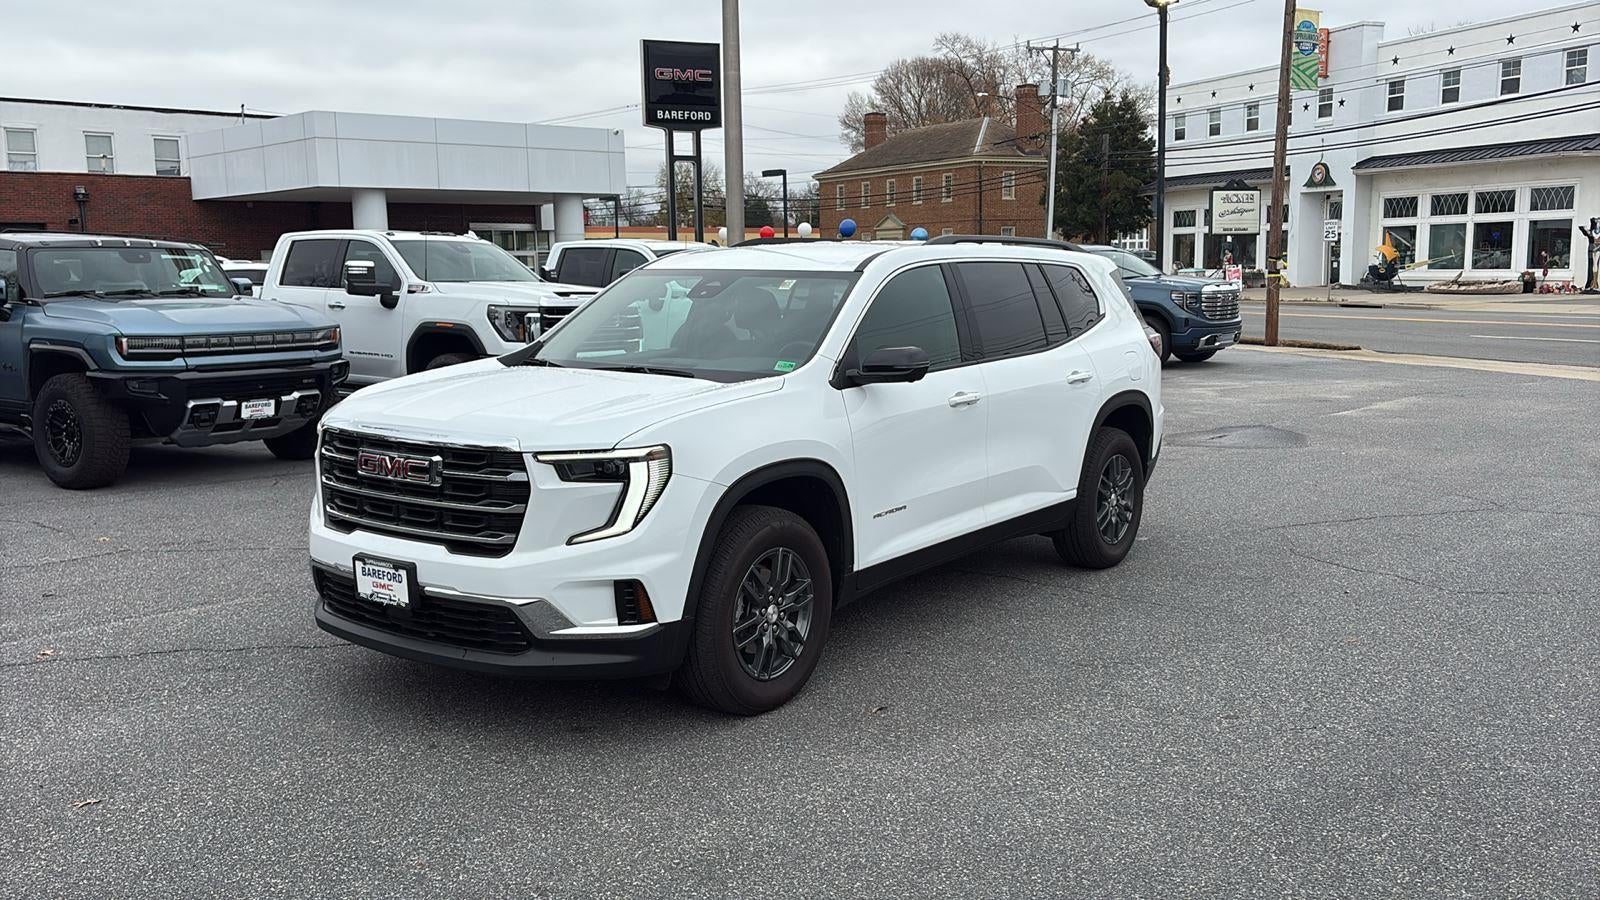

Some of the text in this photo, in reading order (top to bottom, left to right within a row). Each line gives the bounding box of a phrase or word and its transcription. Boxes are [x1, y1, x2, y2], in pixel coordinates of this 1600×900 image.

[655, 67, 712, 82] GMC
[656, 110, 712, 121] BAREFORD
[1324, 230, 1337, 239] 25
[357, 452, 430, 482] GMC
[873, 505, 907, 519] ACADIA
[361, 566, 404, 584] BAREFORD
[371, 581, 394, 592] GMC
